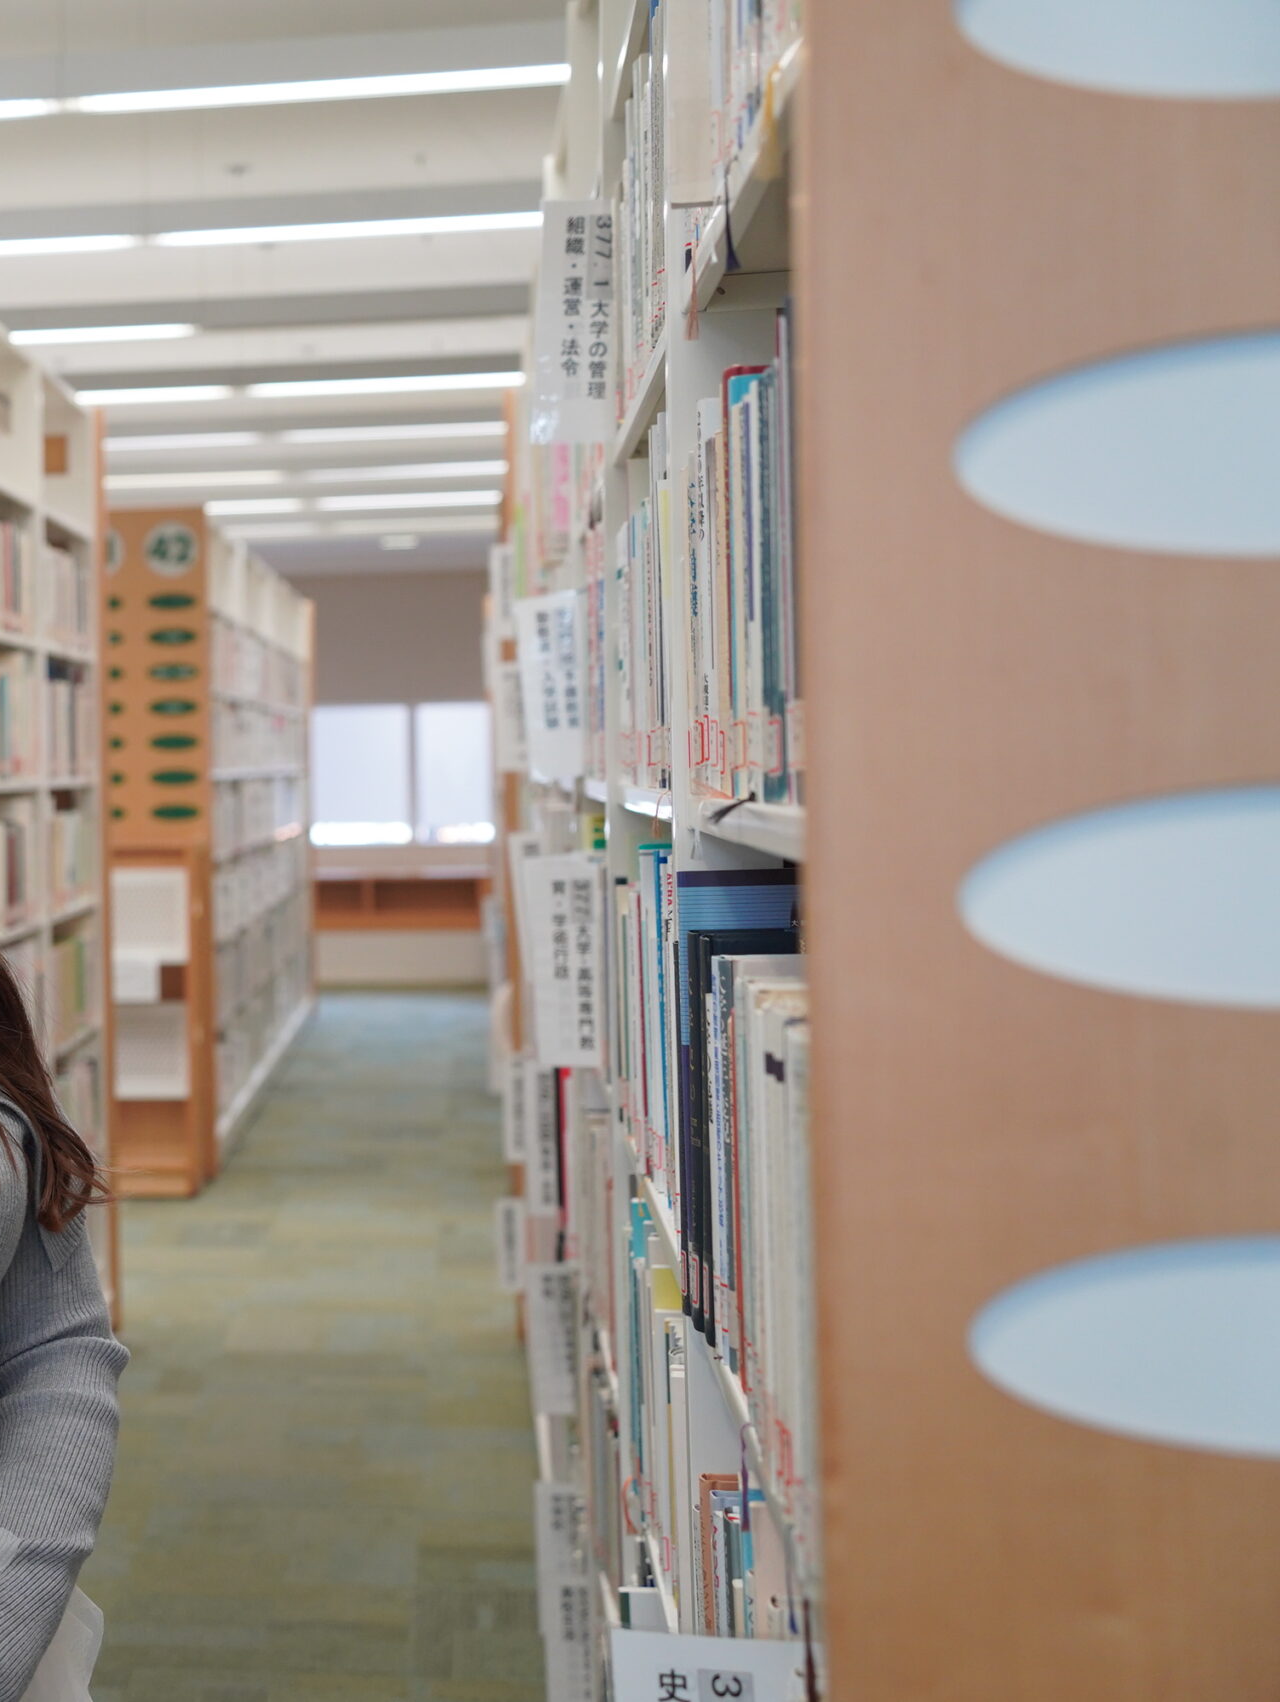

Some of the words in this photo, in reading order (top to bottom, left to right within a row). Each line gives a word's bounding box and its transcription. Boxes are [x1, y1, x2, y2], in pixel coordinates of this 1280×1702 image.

[593, 215, 614, 288] 377.1
[561, 216, 586, 377] 組織・運営・法令
[587, 300, 609, 399] 大学の管理
[658, 1668, 691, 1702] 史
[711, 1673, 742, 1698] 3
